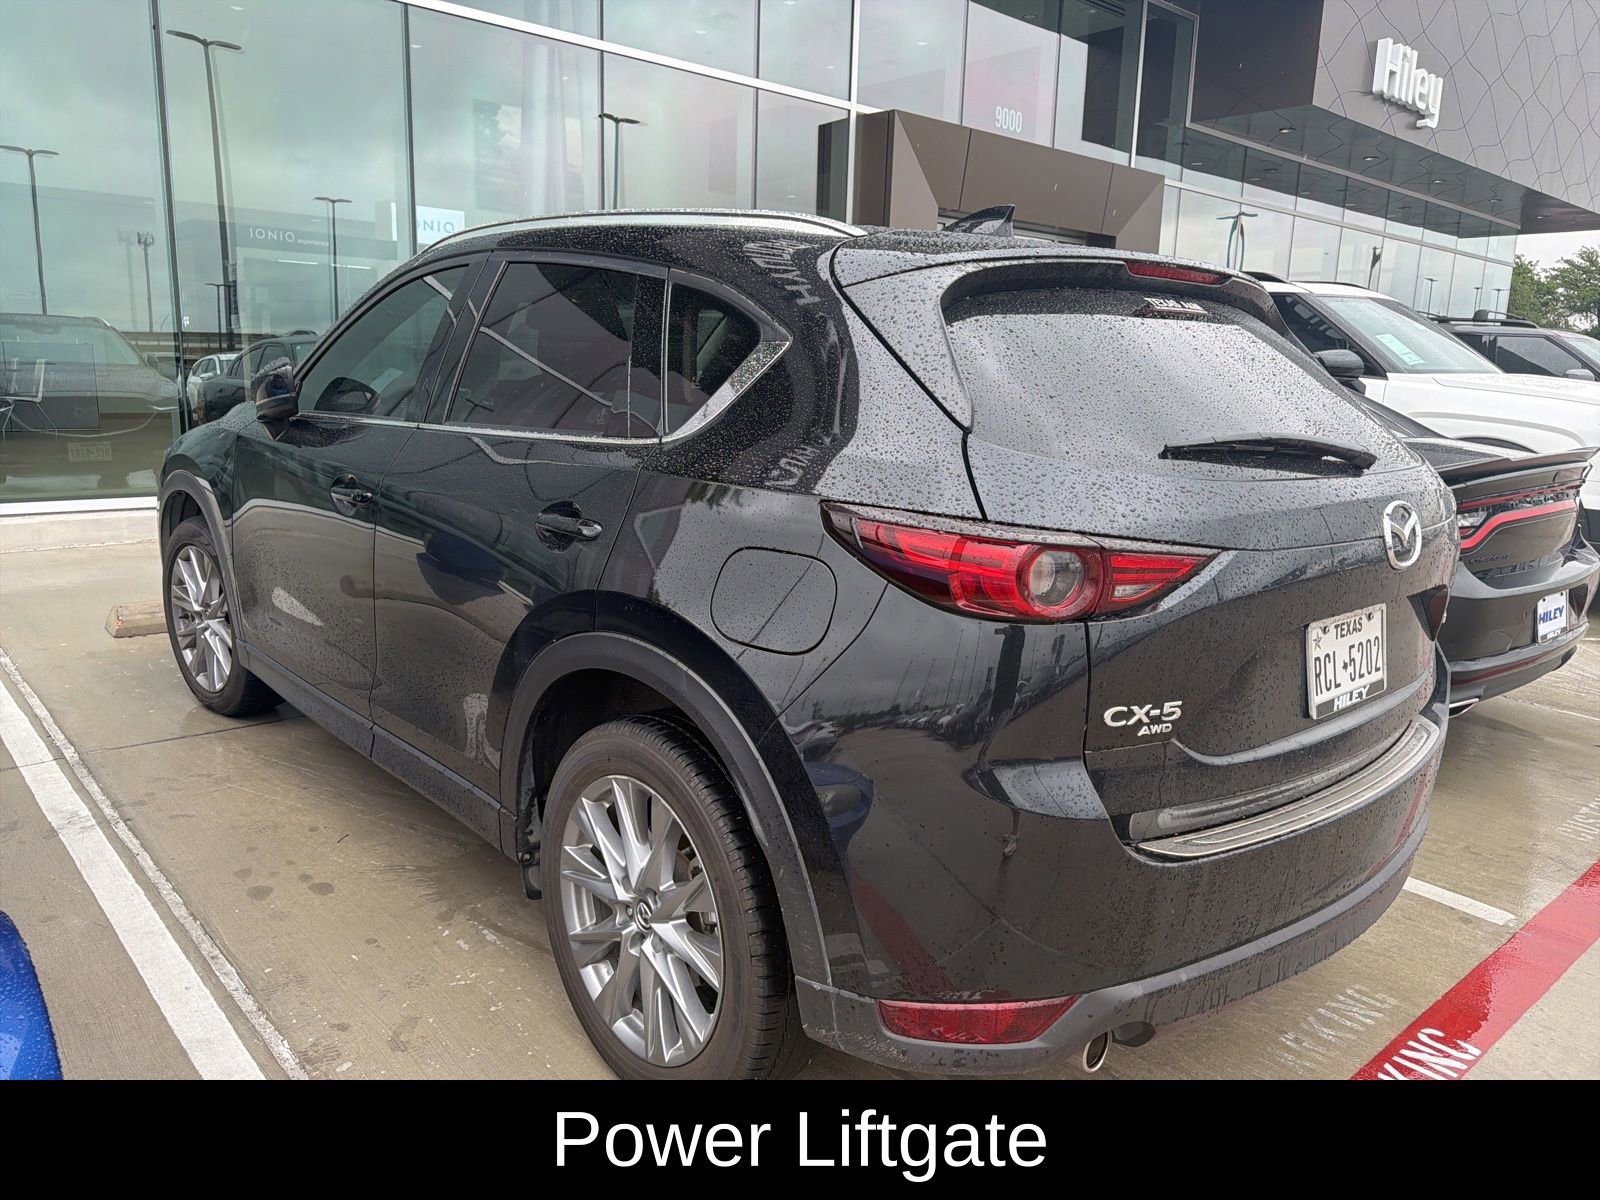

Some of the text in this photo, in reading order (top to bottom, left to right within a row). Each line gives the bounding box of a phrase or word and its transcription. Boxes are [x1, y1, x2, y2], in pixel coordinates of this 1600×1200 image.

[1372, 37, 1444, 129] Hiley
[995, 106, 1023, 133] 9000
[249, 227, 295, 243] IONIQ
[416, 219, 455, 234] NIQ
[1538, 605, 1565, 625] HILEY
[1334, 617, 1363, 640] TEXAS
[1333, 685, 1370, 711] HILEY
[1103, 701, 1183, 727] CX-5
[1137, 723, 1173, 736] AWD
